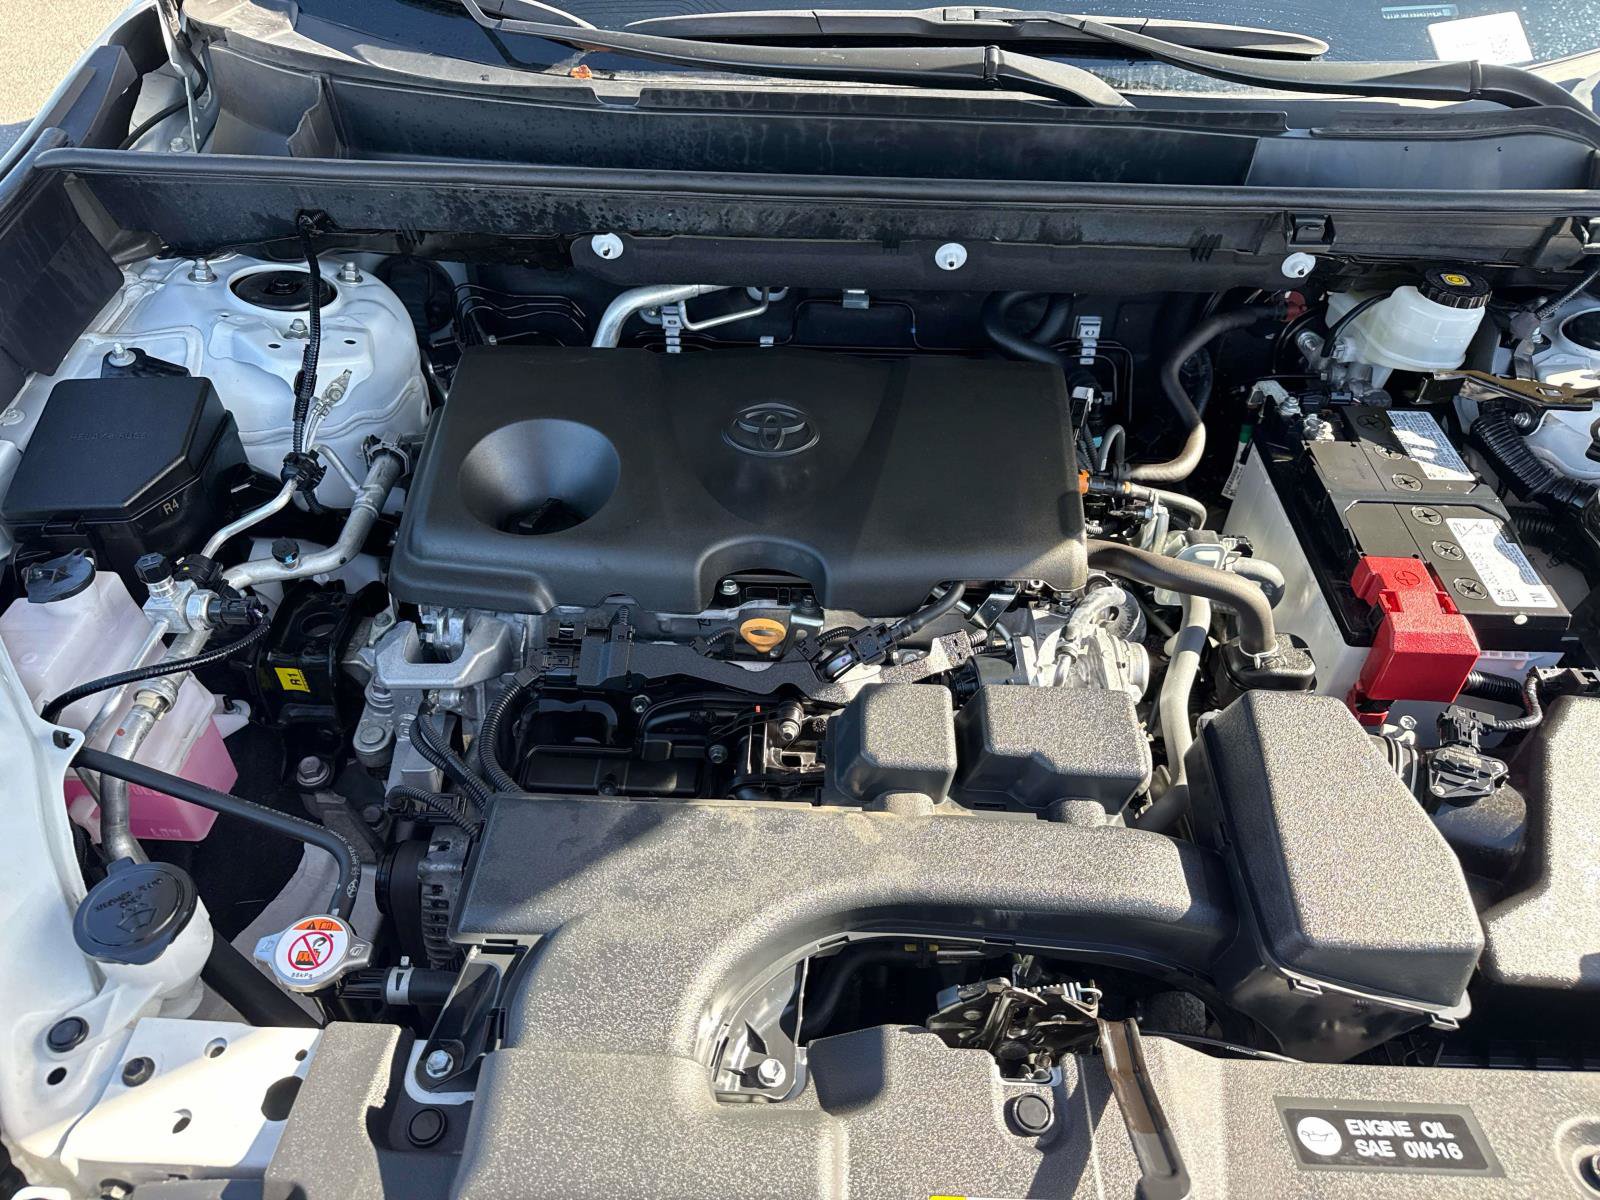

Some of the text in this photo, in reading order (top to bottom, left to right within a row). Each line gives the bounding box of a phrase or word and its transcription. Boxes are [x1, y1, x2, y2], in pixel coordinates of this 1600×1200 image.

[163, 498, 180, 515] R4
[287, 673, 303, 686] R1
[1344, 1118, 1455, 1139] ENGINE OIL
[1354, 1139, 1464, 1160] SAE 0W-16
